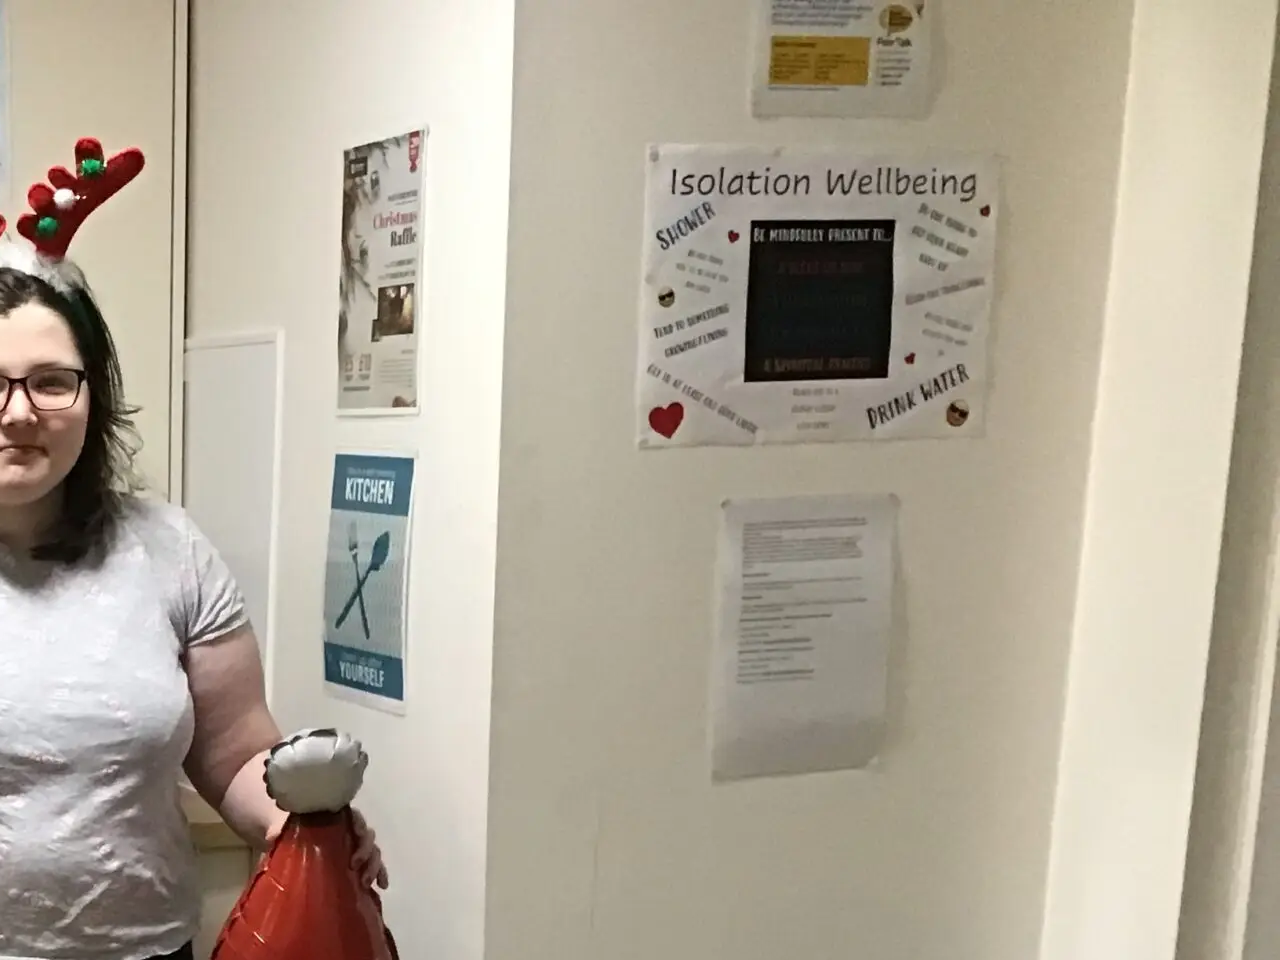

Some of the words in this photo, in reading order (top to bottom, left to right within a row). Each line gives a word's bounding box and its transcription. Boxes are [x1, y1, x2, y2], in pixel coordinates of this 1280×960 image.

[671, 167, 810, 196] Isolation
[827, 167, 977, 202] Wellbeing
[373, 211, 418, 230] Christmas
[656, 201, 716, 250] SHOWER
[390, 227, 417, 247] Raffle
[828, 228, 870, 242] PRESENT
[866, 389, 917, 430] DRINK
[919, 363, 969, 401] WATER
[345, 478, 394, 505] KITCHEN
[339, 661, 384, 687] YOURSELF
